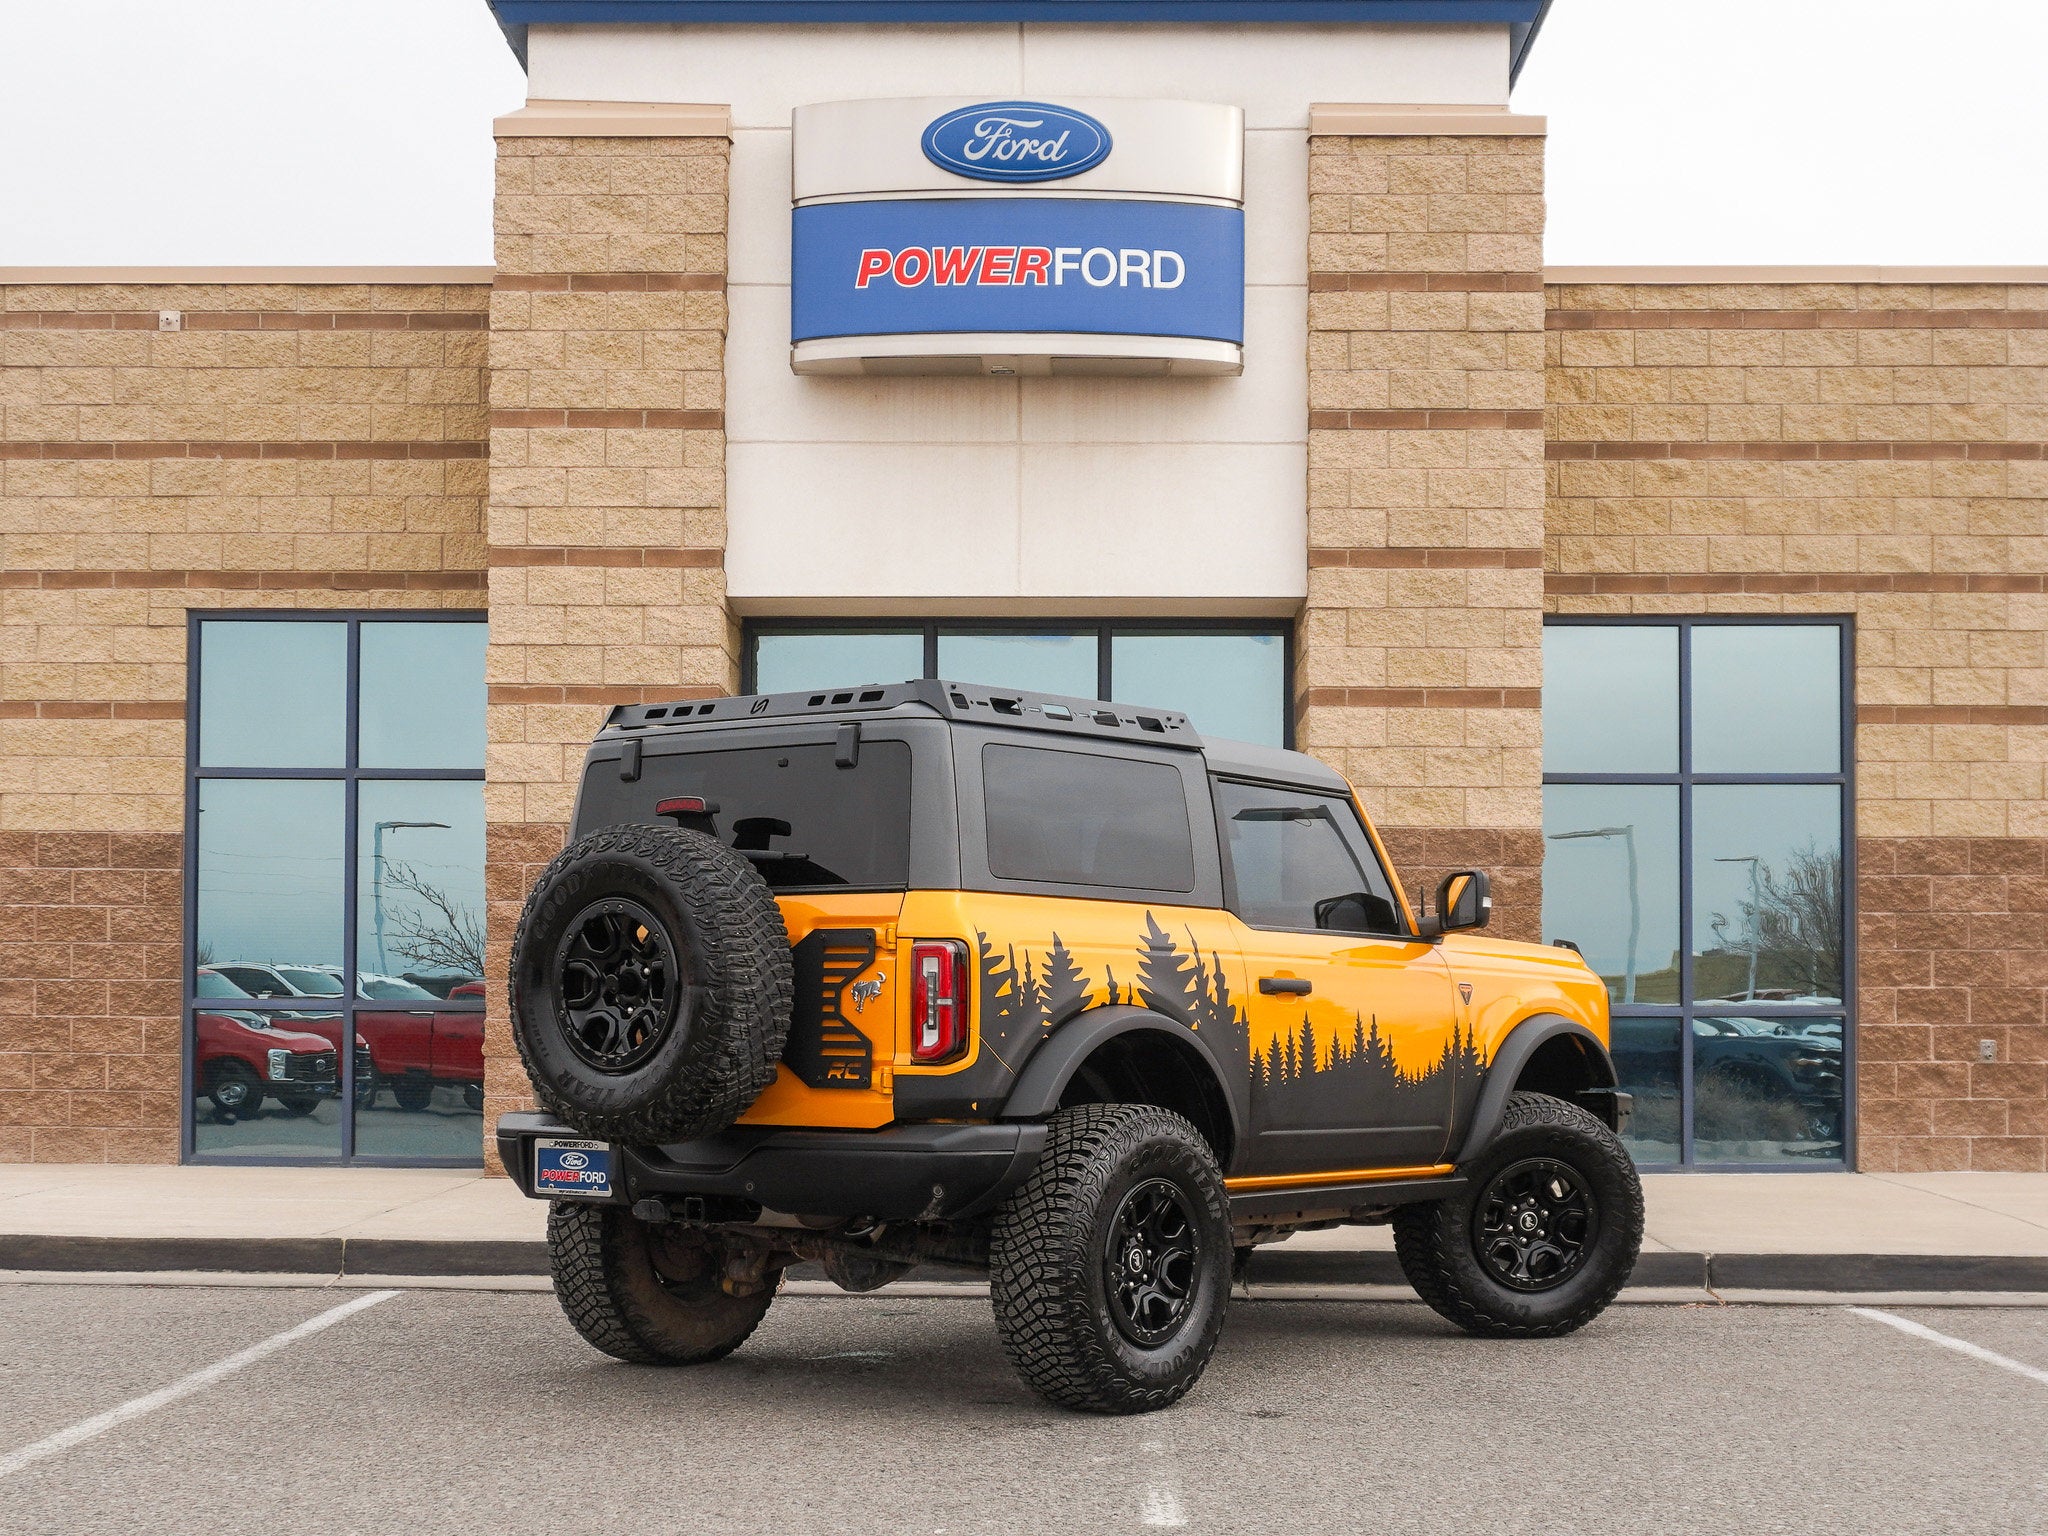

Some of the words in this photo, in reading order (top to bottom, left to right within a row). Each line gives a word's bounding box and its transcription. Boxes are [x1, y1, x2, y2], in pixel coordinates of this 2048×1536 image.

[963, 116, 1071, 163] Ford
[855, 246, 1186, 289] POWERFORD
[827, 1061, 862, 1080] RC
[554, 1140, 593, 1149] POWERFORD
[565, 1154, 582, 1166] Ford
[541, 1170, 606, 1183] POWERFORD
